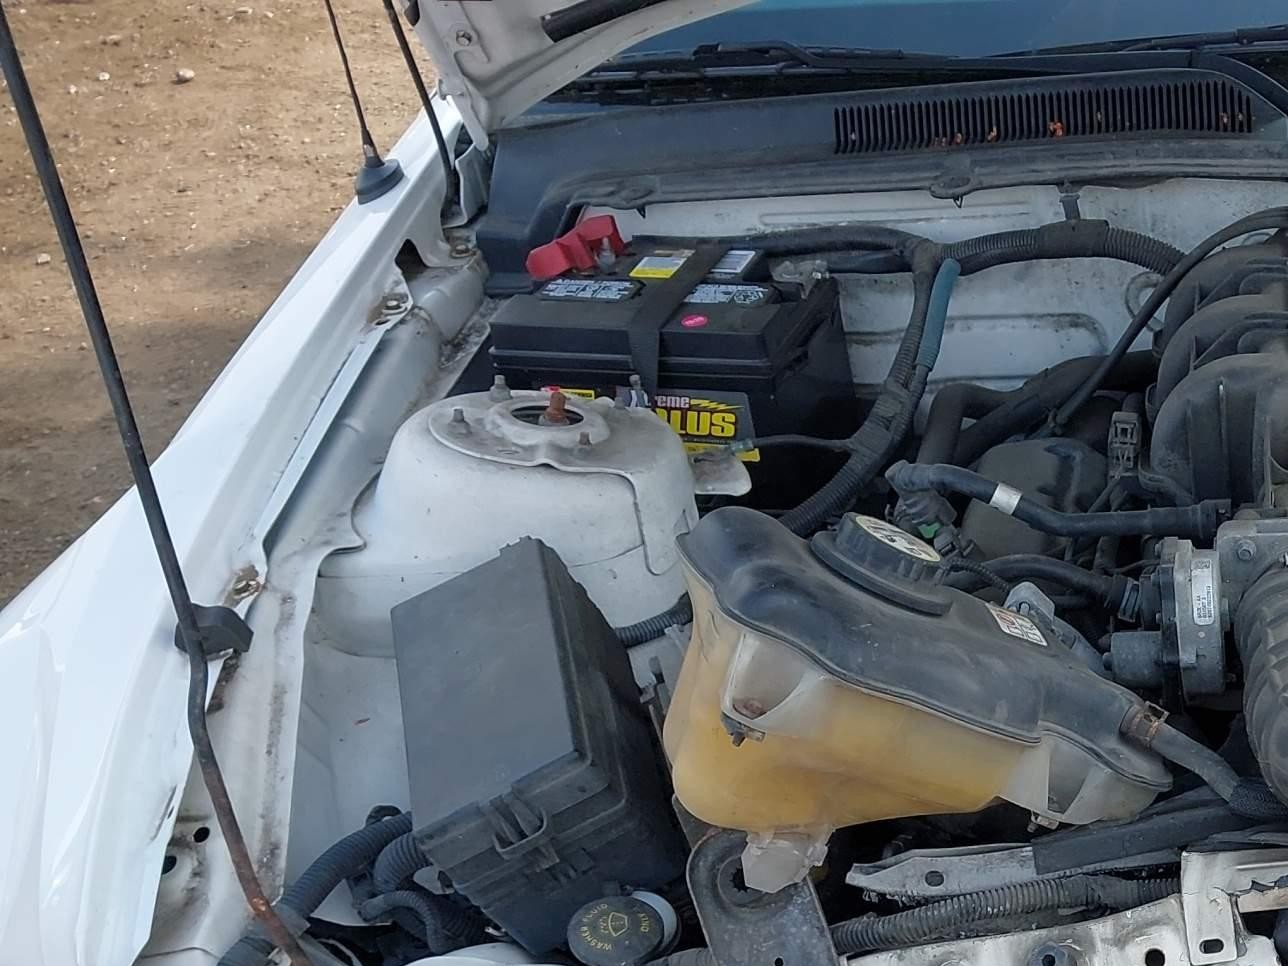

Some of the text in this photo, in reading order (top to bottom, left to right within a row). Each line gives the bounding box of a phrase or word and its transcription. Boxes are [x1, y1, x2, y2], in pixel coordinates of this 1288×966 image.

[580, 903, 614, 951] WASHER FLUID
[638, 912, 650, 933] ONLY
